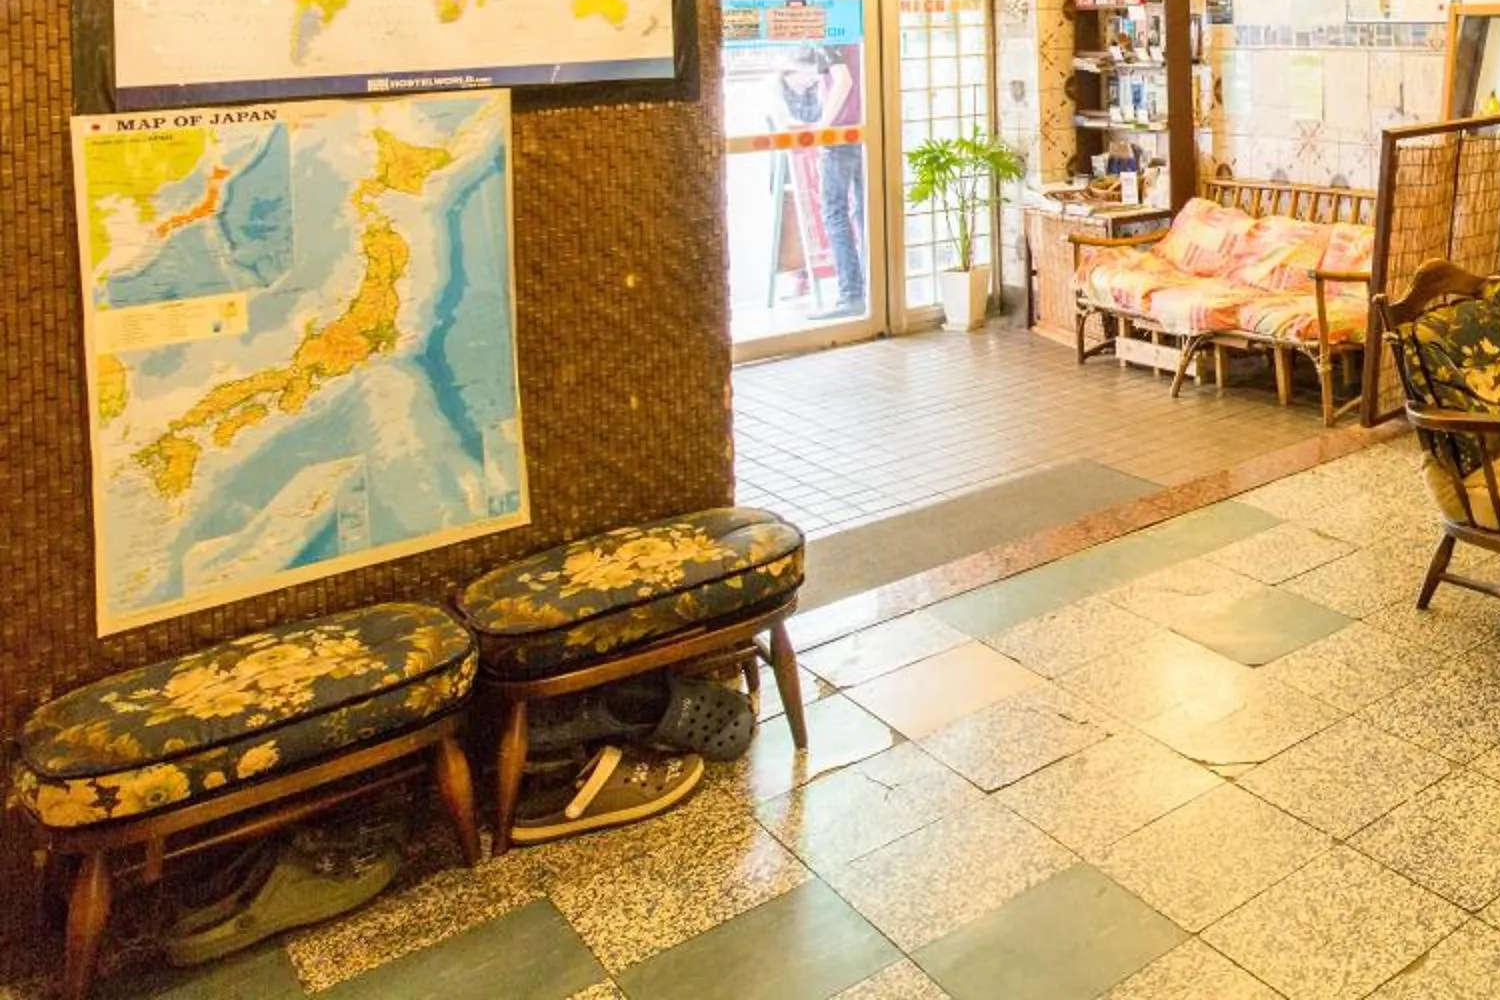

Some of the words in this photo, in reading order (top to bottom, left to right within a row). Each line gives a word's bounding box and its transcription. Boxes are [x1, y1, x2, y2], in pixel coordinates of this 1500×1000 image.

[116, 117, 166, 132] MAP
[173, 115, 203, 128] OF
[209, 109, 278, 125] JAPAN
